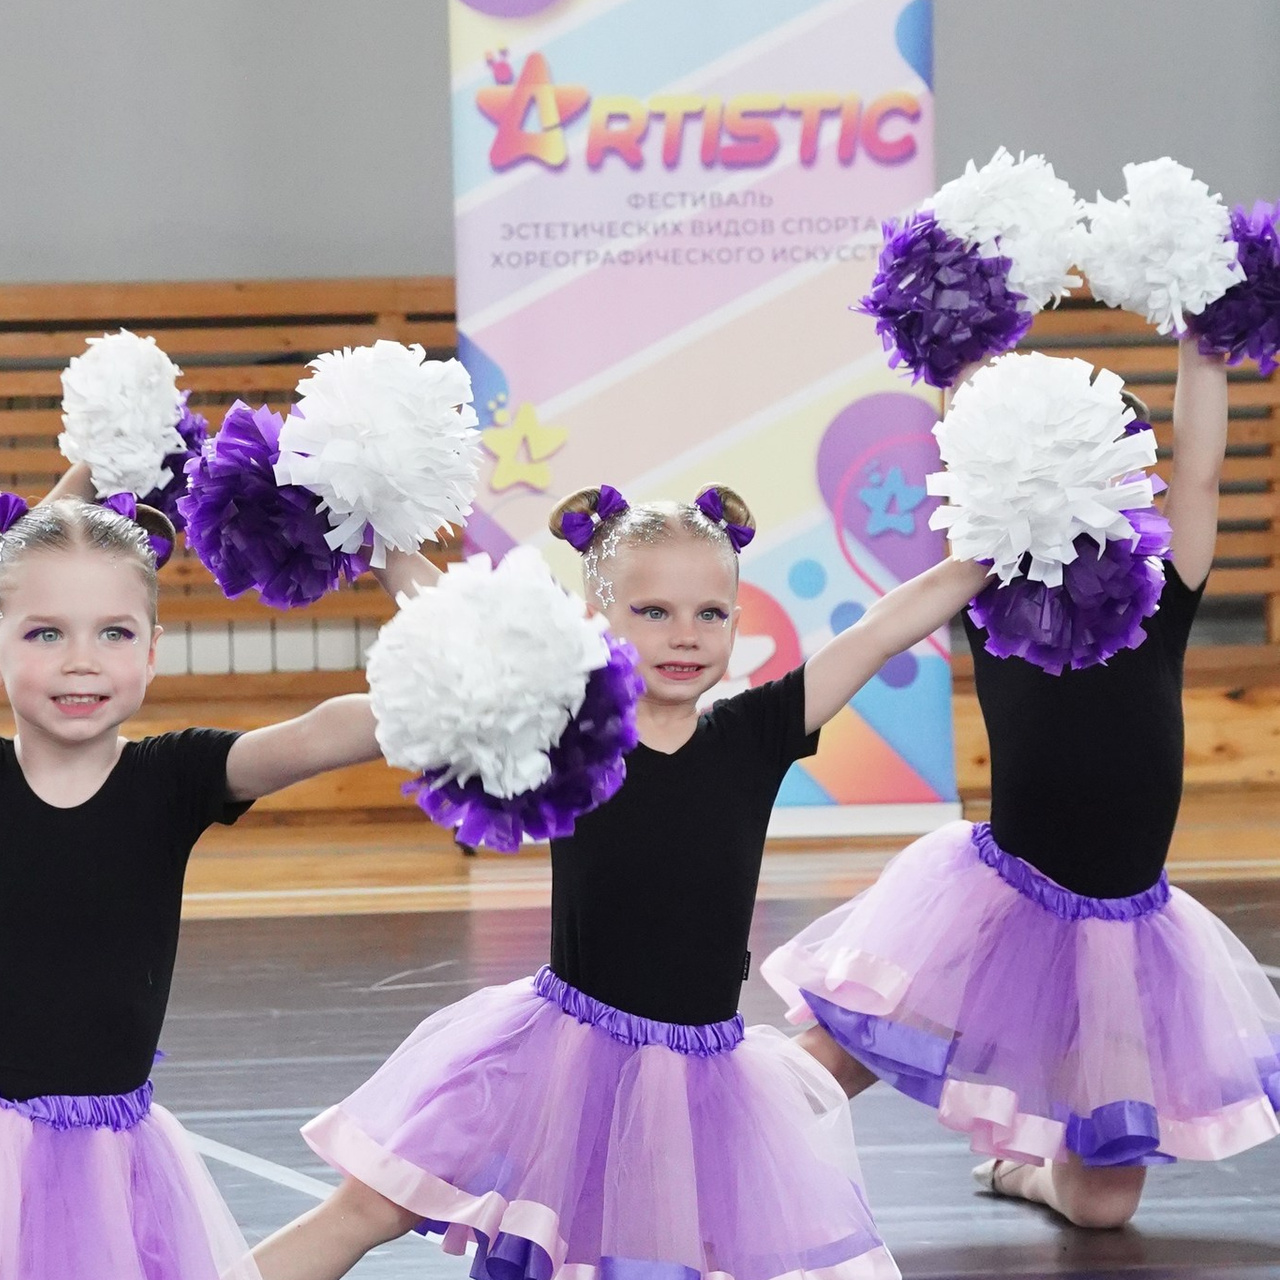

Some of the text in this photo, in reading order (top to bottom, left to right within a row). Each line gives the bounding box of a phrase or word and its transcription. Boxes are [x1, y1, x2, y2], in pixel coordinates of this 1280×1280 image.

[475, 50, 921, 173] ARTISTIC
[626, 190, 774, 210] ФЕСТИВАЛЬ
[500, 216, 878, 241] ЭСТЕТИЧЕСКИХ ВИДОВ СПОРТА
[490, 243, 881, 270] ХОРЕОГРАФИЧЕСКОГО ИСКУССТ
